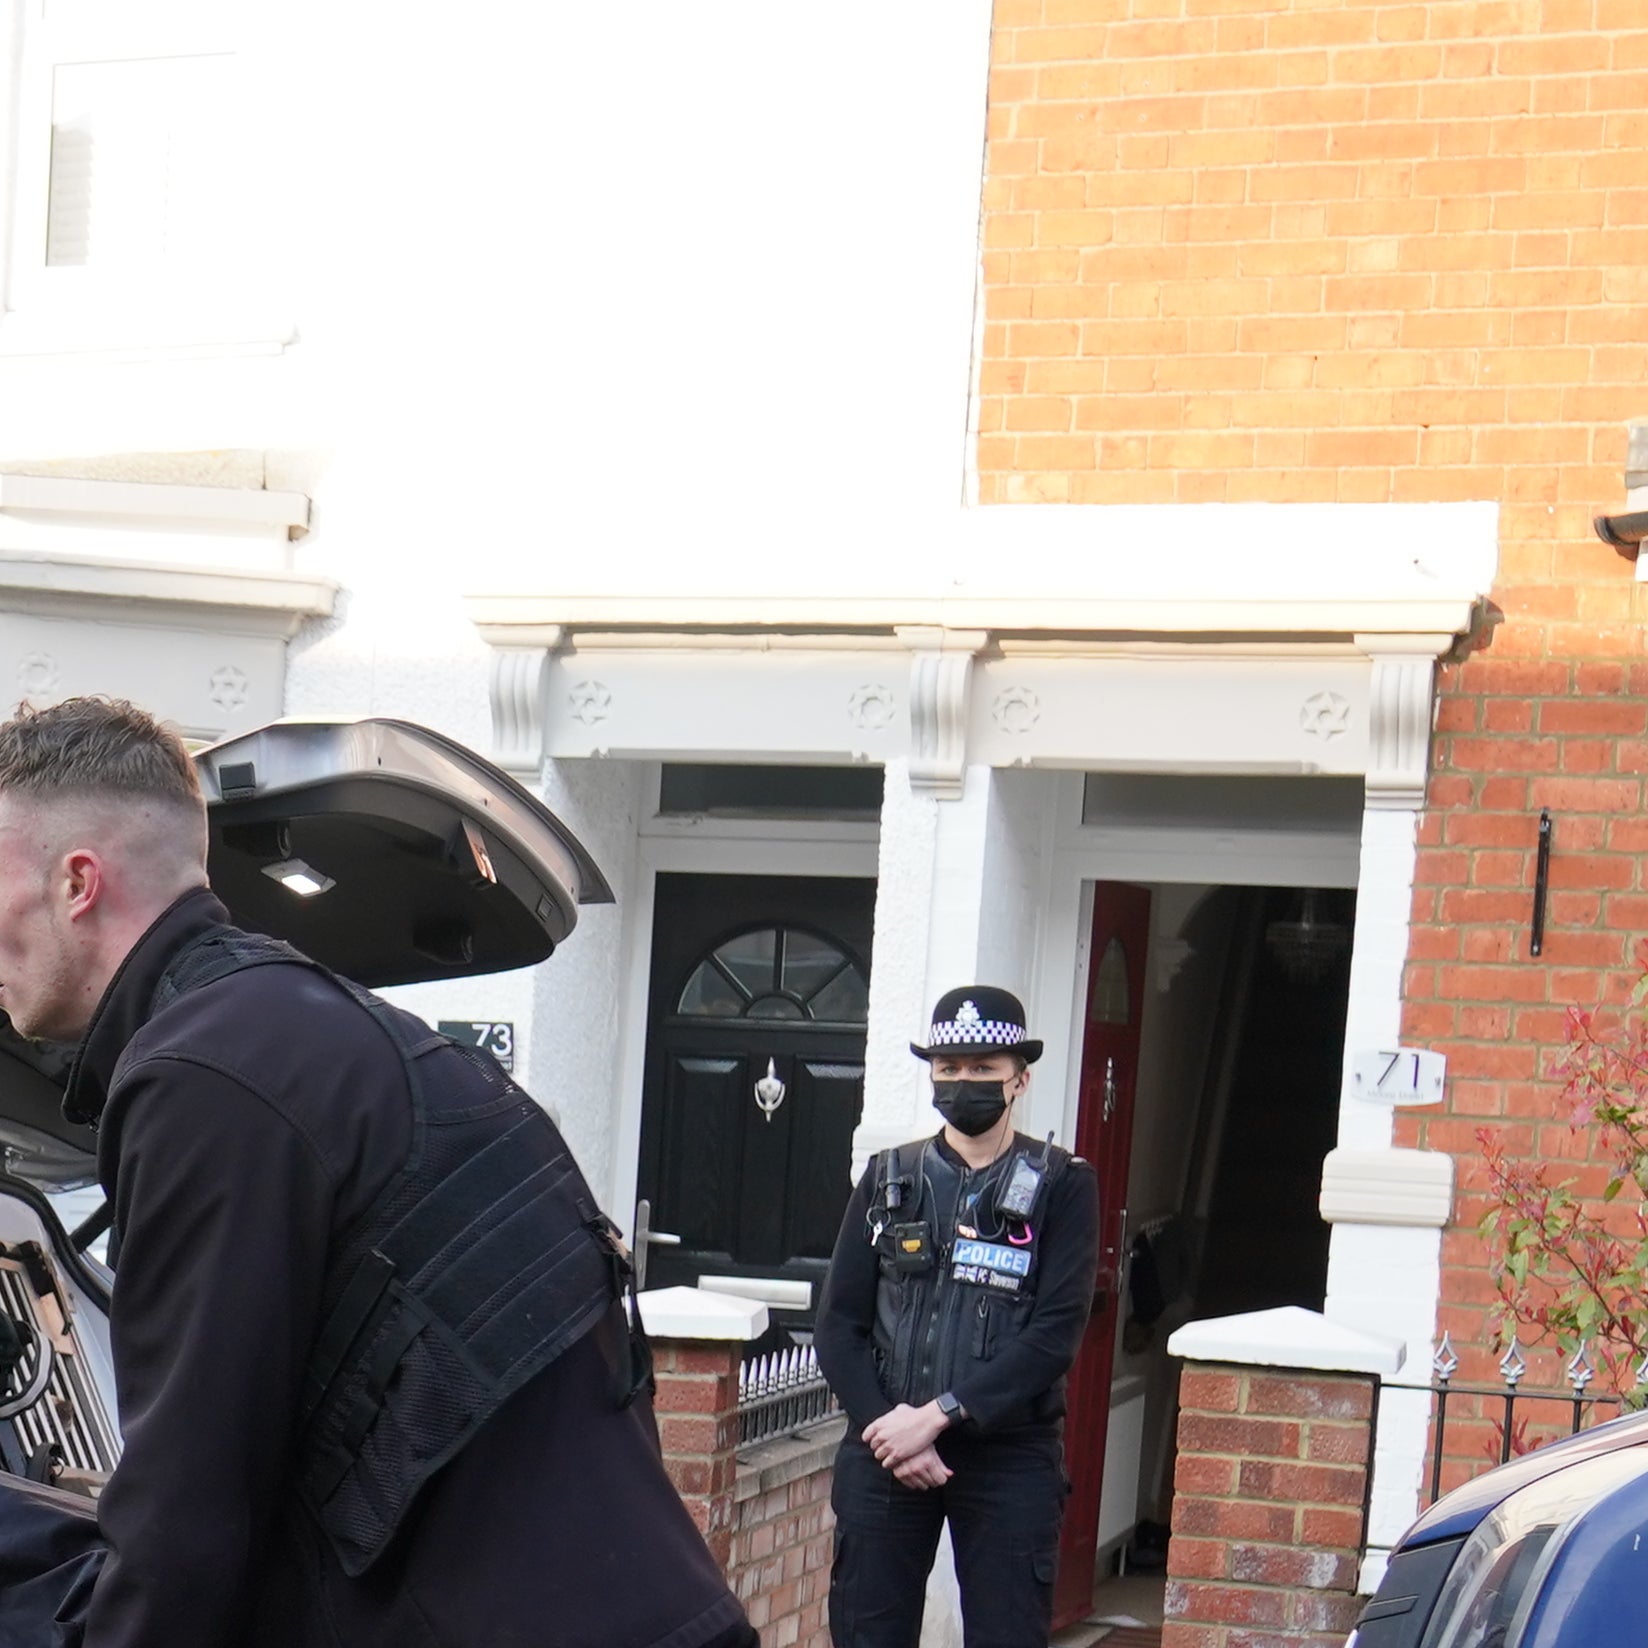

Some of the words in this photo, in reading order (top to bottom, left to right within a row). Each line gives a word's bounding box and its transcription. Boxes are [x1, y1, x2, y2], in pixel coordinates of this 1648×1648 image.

[471, 1023, 513, 1056] 73
[1377, 1051, 1420, 1089] 71
[956, 1242, 1024, 1272] POLICE
